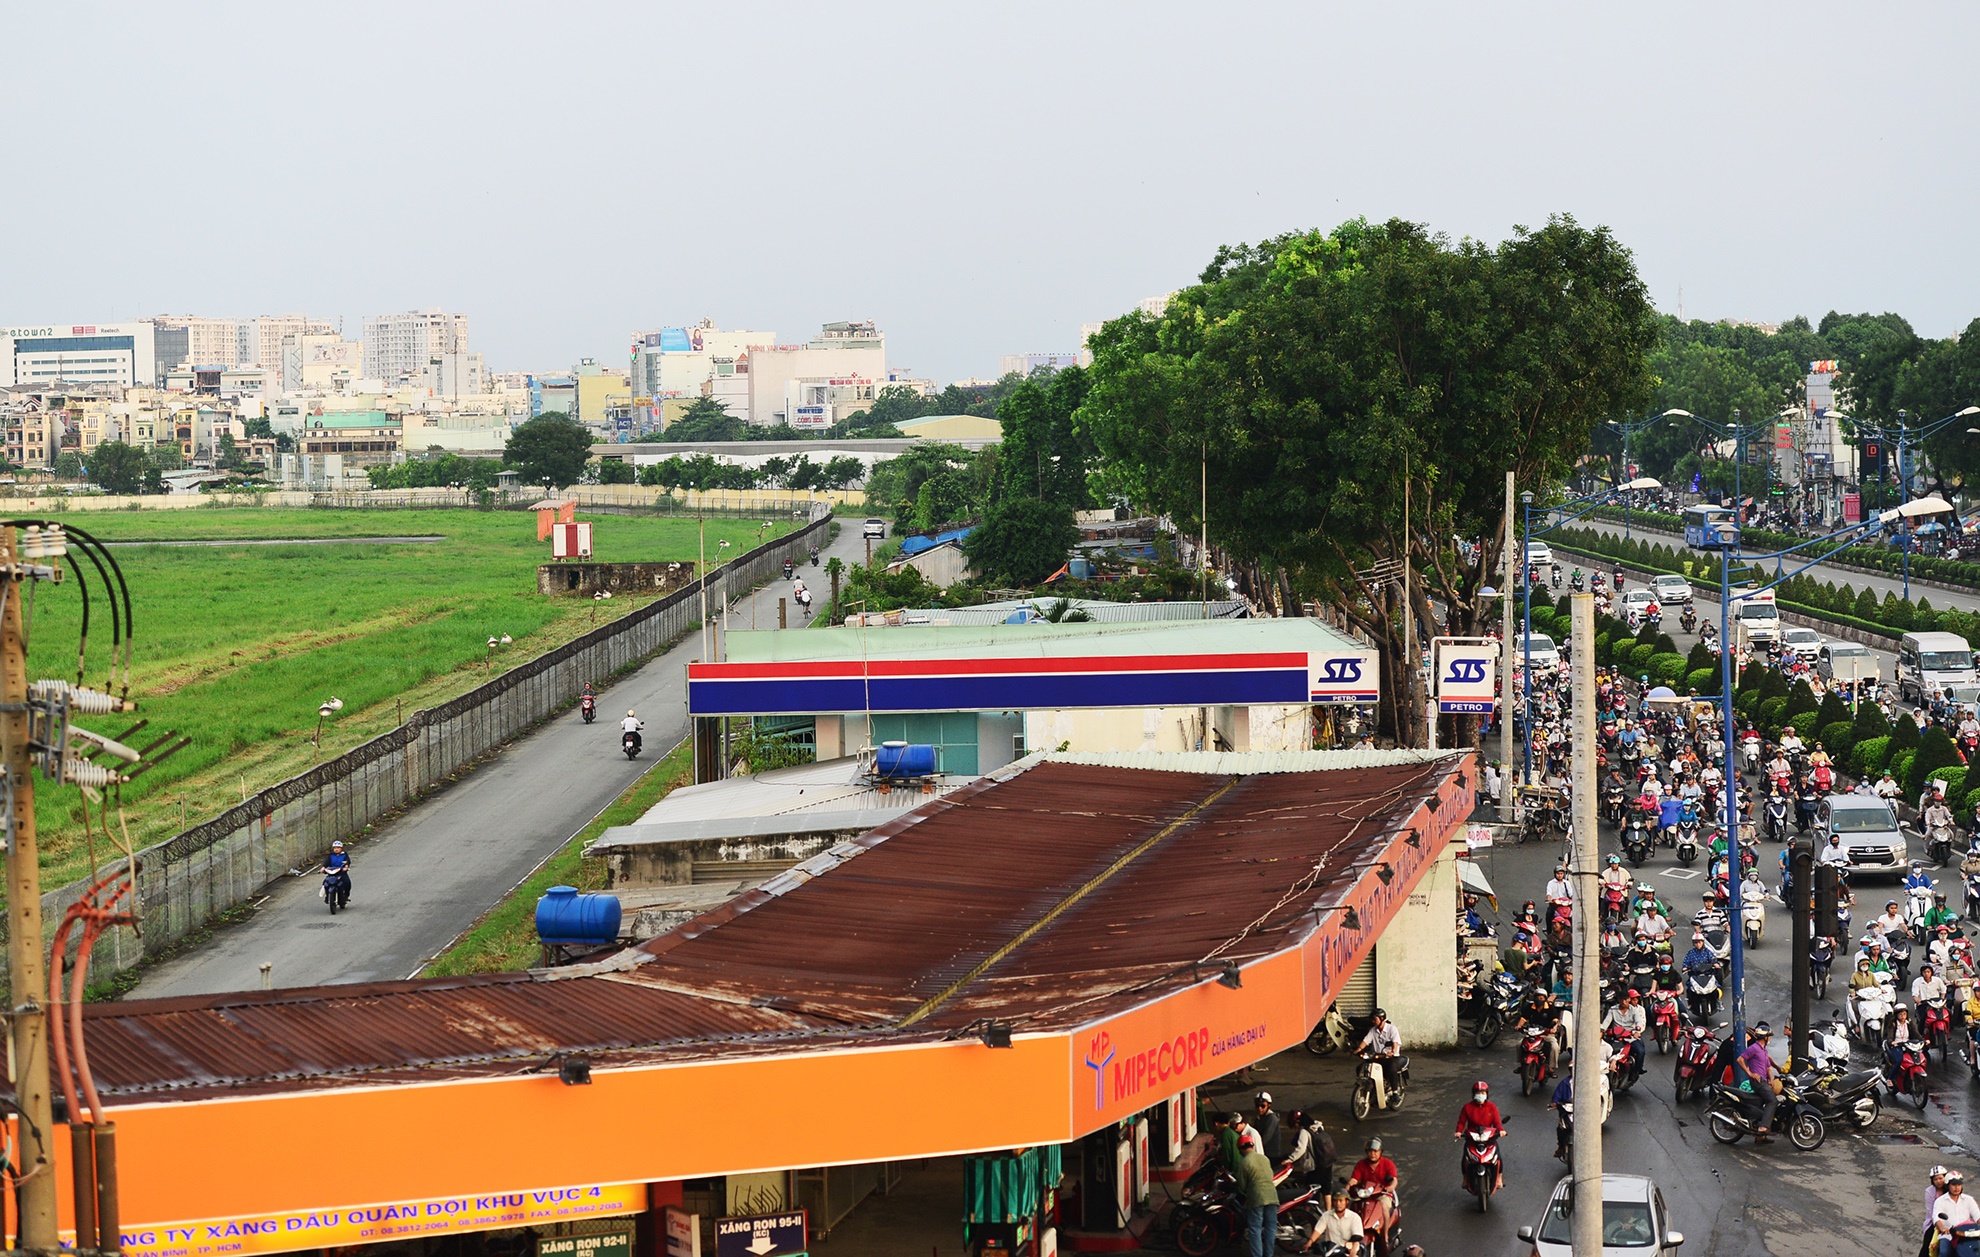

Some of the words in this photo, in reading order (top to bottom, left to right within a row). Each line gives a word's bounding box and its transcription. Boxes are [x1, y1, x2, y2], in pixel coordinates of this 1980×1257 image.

[1450, 703, 1483, 711] PETRO
[1114, 1027, 1209, 1101] MIPECORP
[165, 1228, 196, 1242] TY
[206, 1220, 277, 1239] XĂNG
[347, 1205, 418, 1224] QUÂN
[426, 1199, 467, 1217] ĐỘI
[476, 1194, 524, 1210] KHU
[588, 1186, 602, 1197] 4
[720, 1221, 751, 1235] XĂNG
[753, 1219, 777, 1231] RON
[779, 1216, 802, 1228] 95-II
[753, 1229, 770, 1239] (KC)
[197, 1245, 214, 1254] TP.
[217, 1243, 241, 1252] HCM
[541, 1241, 574, 1254] XĂNG
[576, 1237, 601, 1249] RON
[603, 1235, 627, 1247] 92-II
